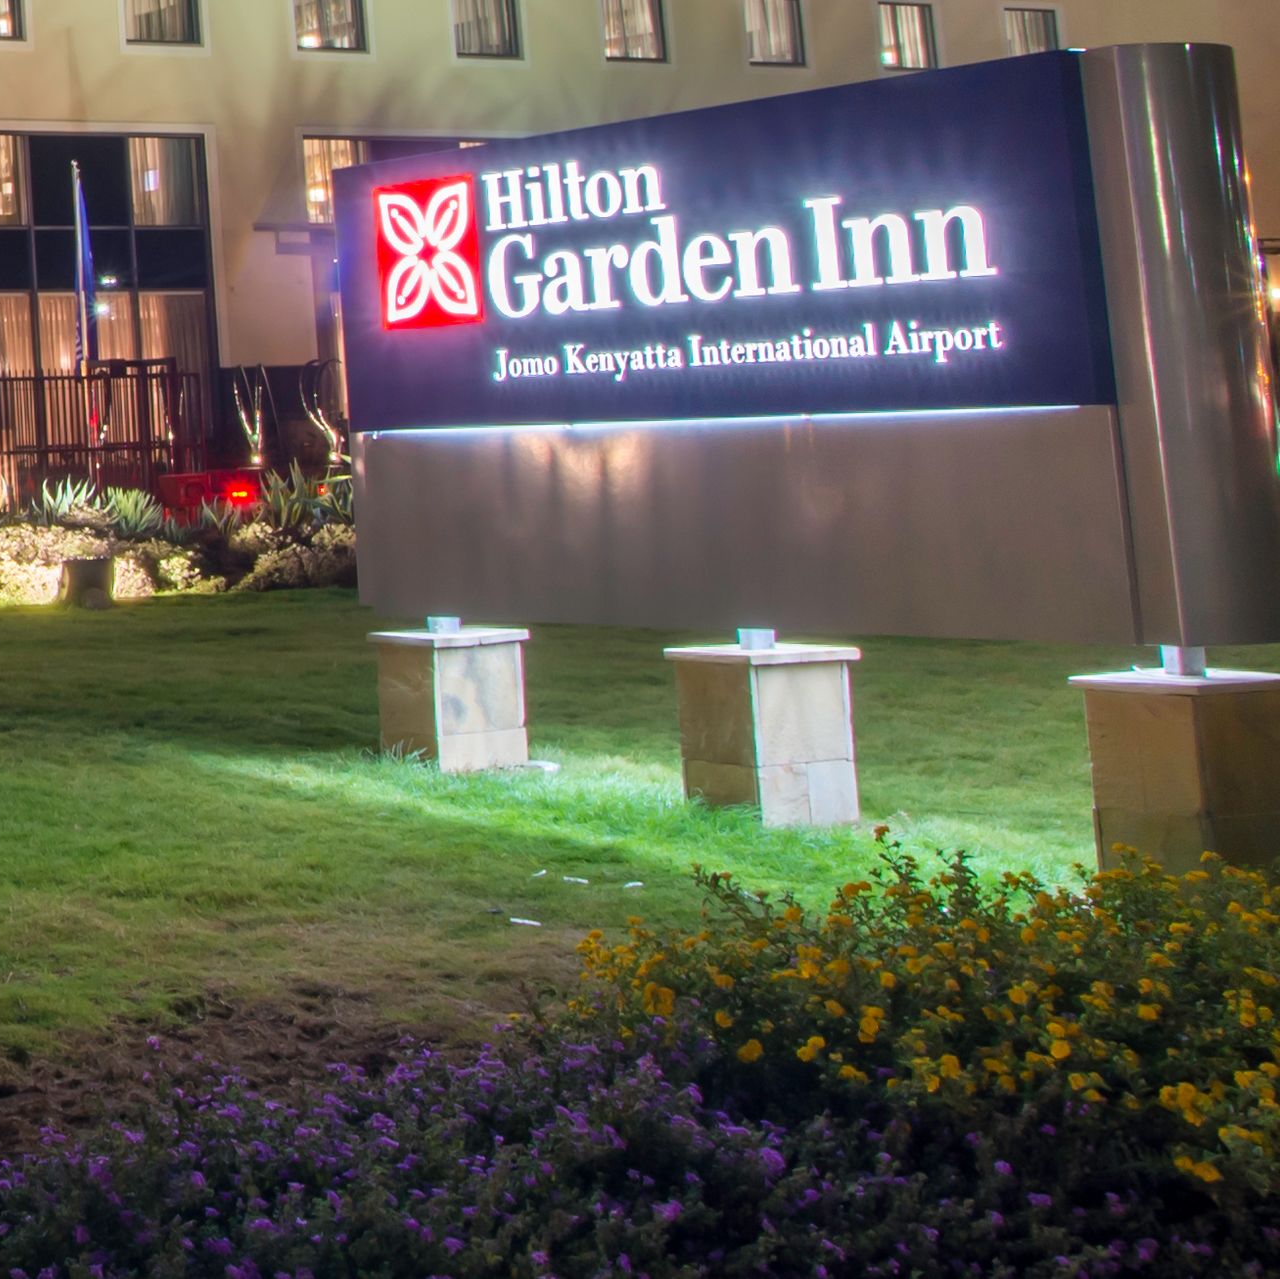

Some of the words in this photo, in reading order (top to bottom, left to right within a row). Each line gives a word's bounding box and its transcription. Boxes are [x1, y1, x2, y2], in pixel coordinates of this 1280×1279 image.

[481, 161, 666, 231] Hilton
[487, 214, 801, 319] Garden
[803, 195, 998, 292] Inn
[493, 348, 559, 382] Jomo
[563, 342, 684, 383] Kenyatta
[688, 322, 877, 368] International
[884, 320, 1003, 364] Airport
